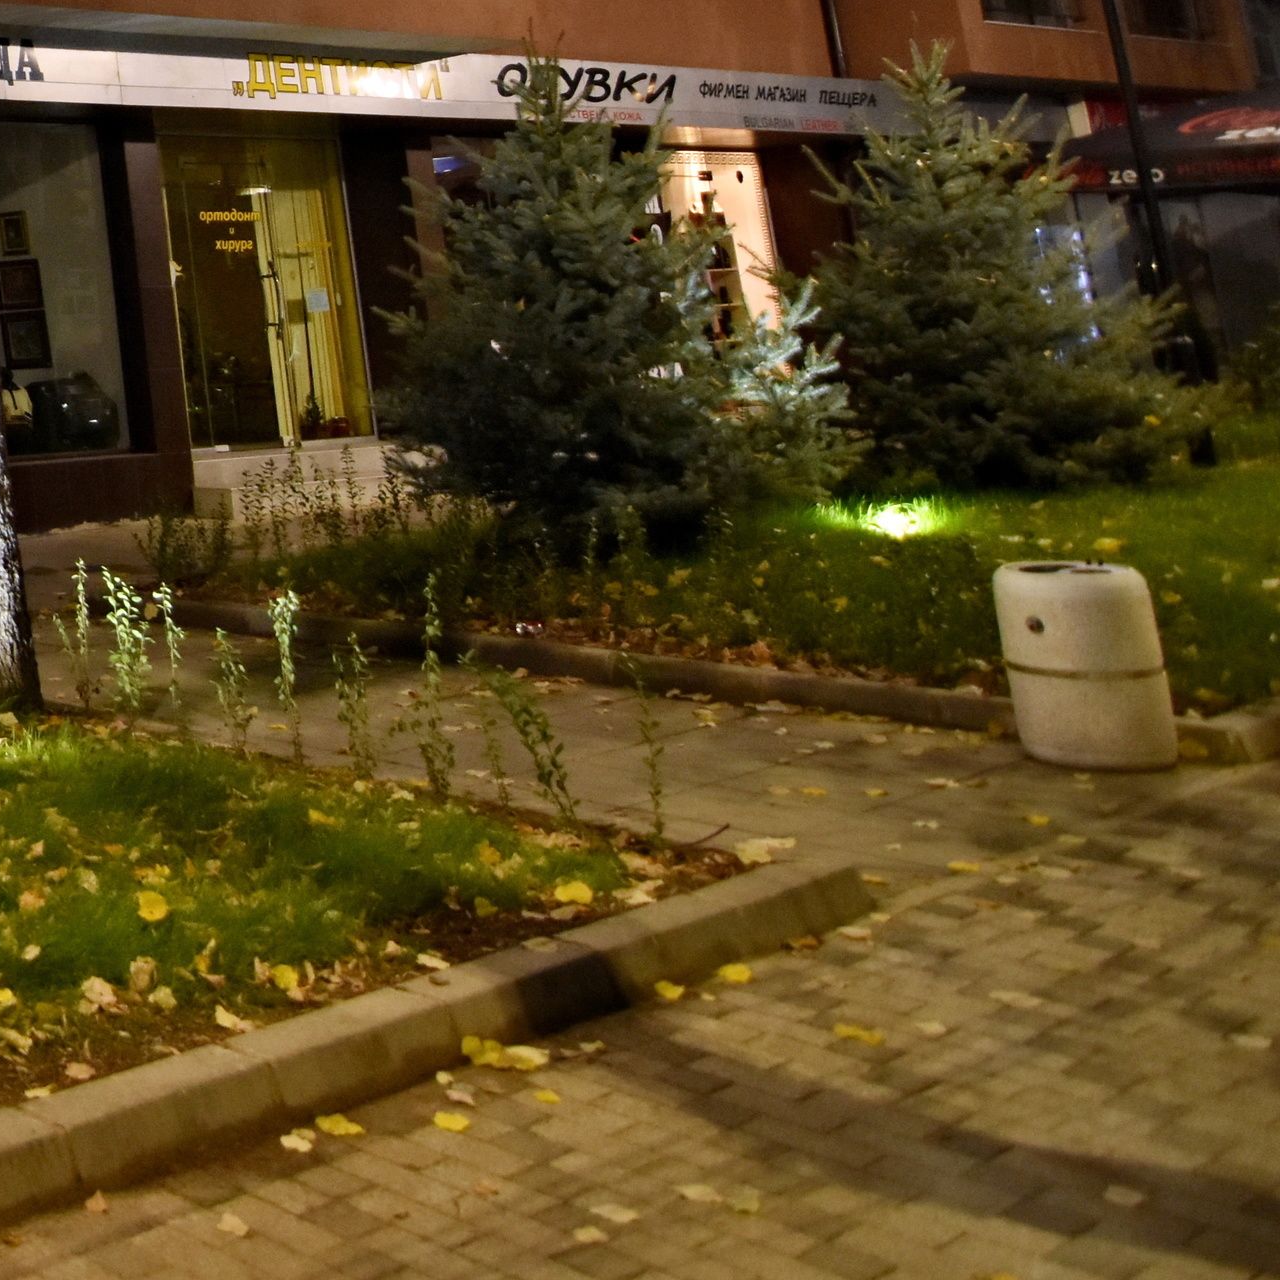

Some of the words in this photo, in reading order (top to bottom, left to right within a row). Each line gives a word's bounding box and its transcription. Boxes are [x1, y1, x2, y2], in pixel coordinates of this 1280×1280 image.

[497, 62, 677, 104] ОУВКИ
[698, 80, 750, 99] ФИРМЕН
[755, 85, 807, 103] МАГАЗИН
[818, 90, 877, 108] ПЕЩЕРА
[1108, 168, 1165, 184] zeo
[199, 208, 261, 224] ортодонт
[215, 239, 253, 253] хирург
